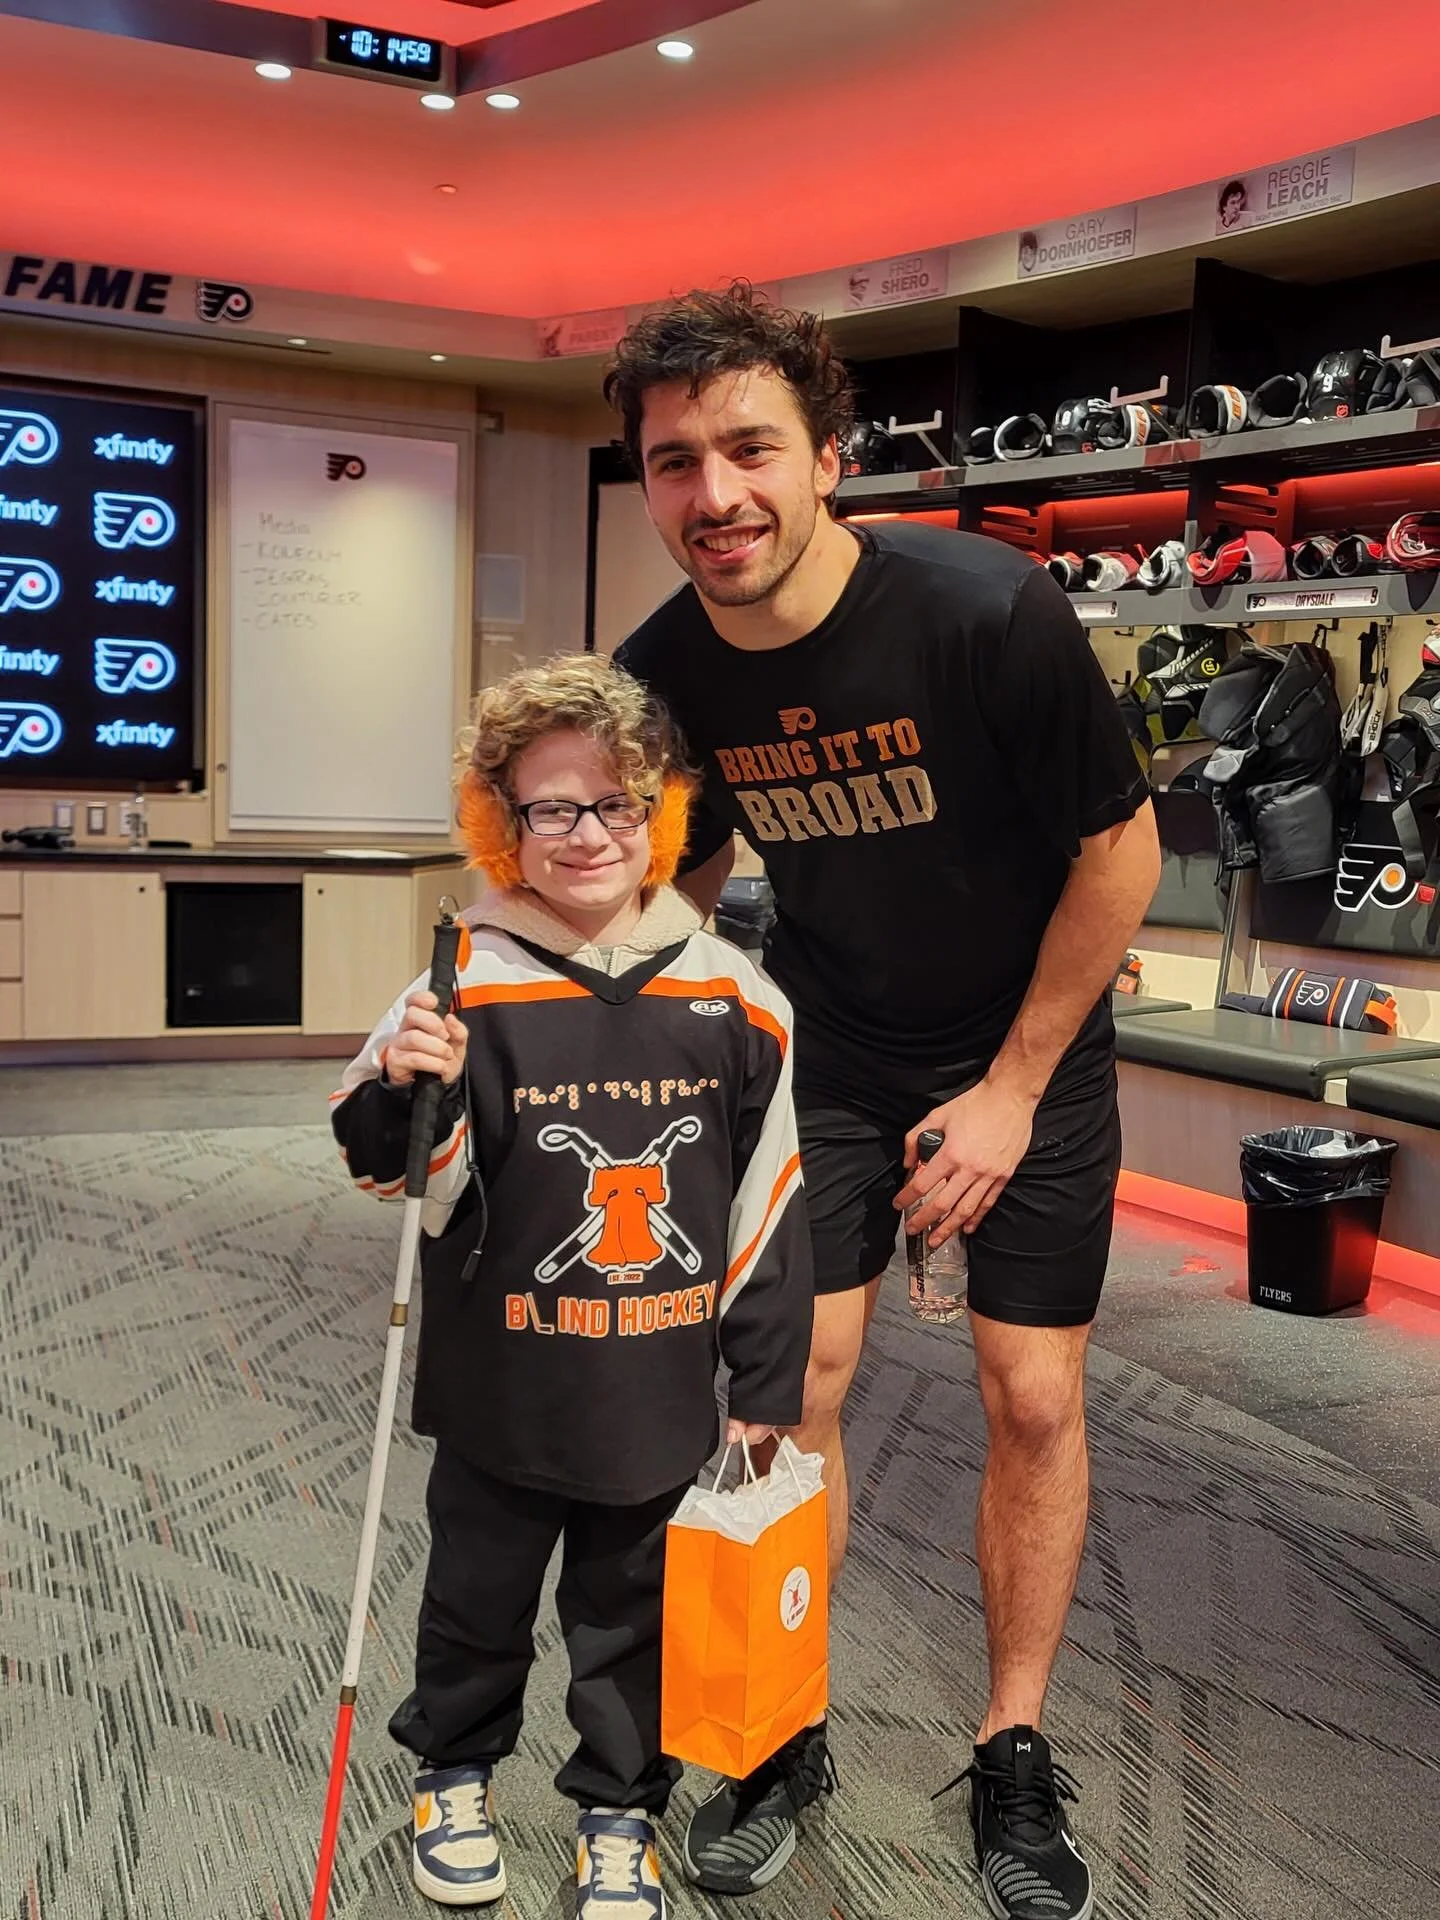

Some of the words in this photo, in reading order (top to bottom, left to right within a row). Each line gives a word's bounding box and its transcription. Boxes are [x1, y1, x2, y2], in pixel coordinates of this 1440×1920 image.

[1268, 156, 1331, 191] REGGIE
[1267, 178, 1328, 210] LEACH
[1065, 216, 1106, 241] GARY
[1039, 229, 1132, 264] DORNHOEFER
[881, 273, 929, 295] SHERO
[889, 258, 922, 280] FRED
[4, 256, 172, 315] FAME
[94, 433, 174, 465] xfinity
[95, 576, 174, 607] xfinity
[1295, 592, 1336, 607] DRYSDALE
[1370, 588, 1378, 604] 9
[96, 719, 174, 748] xfinity
[714, 740, 817, 783] BRING
[819, 730, 863, 771] IT
[866, 717, 921, 761] TO
[734, 765, 938, 841] BROAD
[624, 1273, 641, 1282] 2022
[505, 1292, 609, 1338] BLIND
[618, 1280, 717, 1336] HOCKEY
[1259, 1285, 1292, 1303] FLYERS
